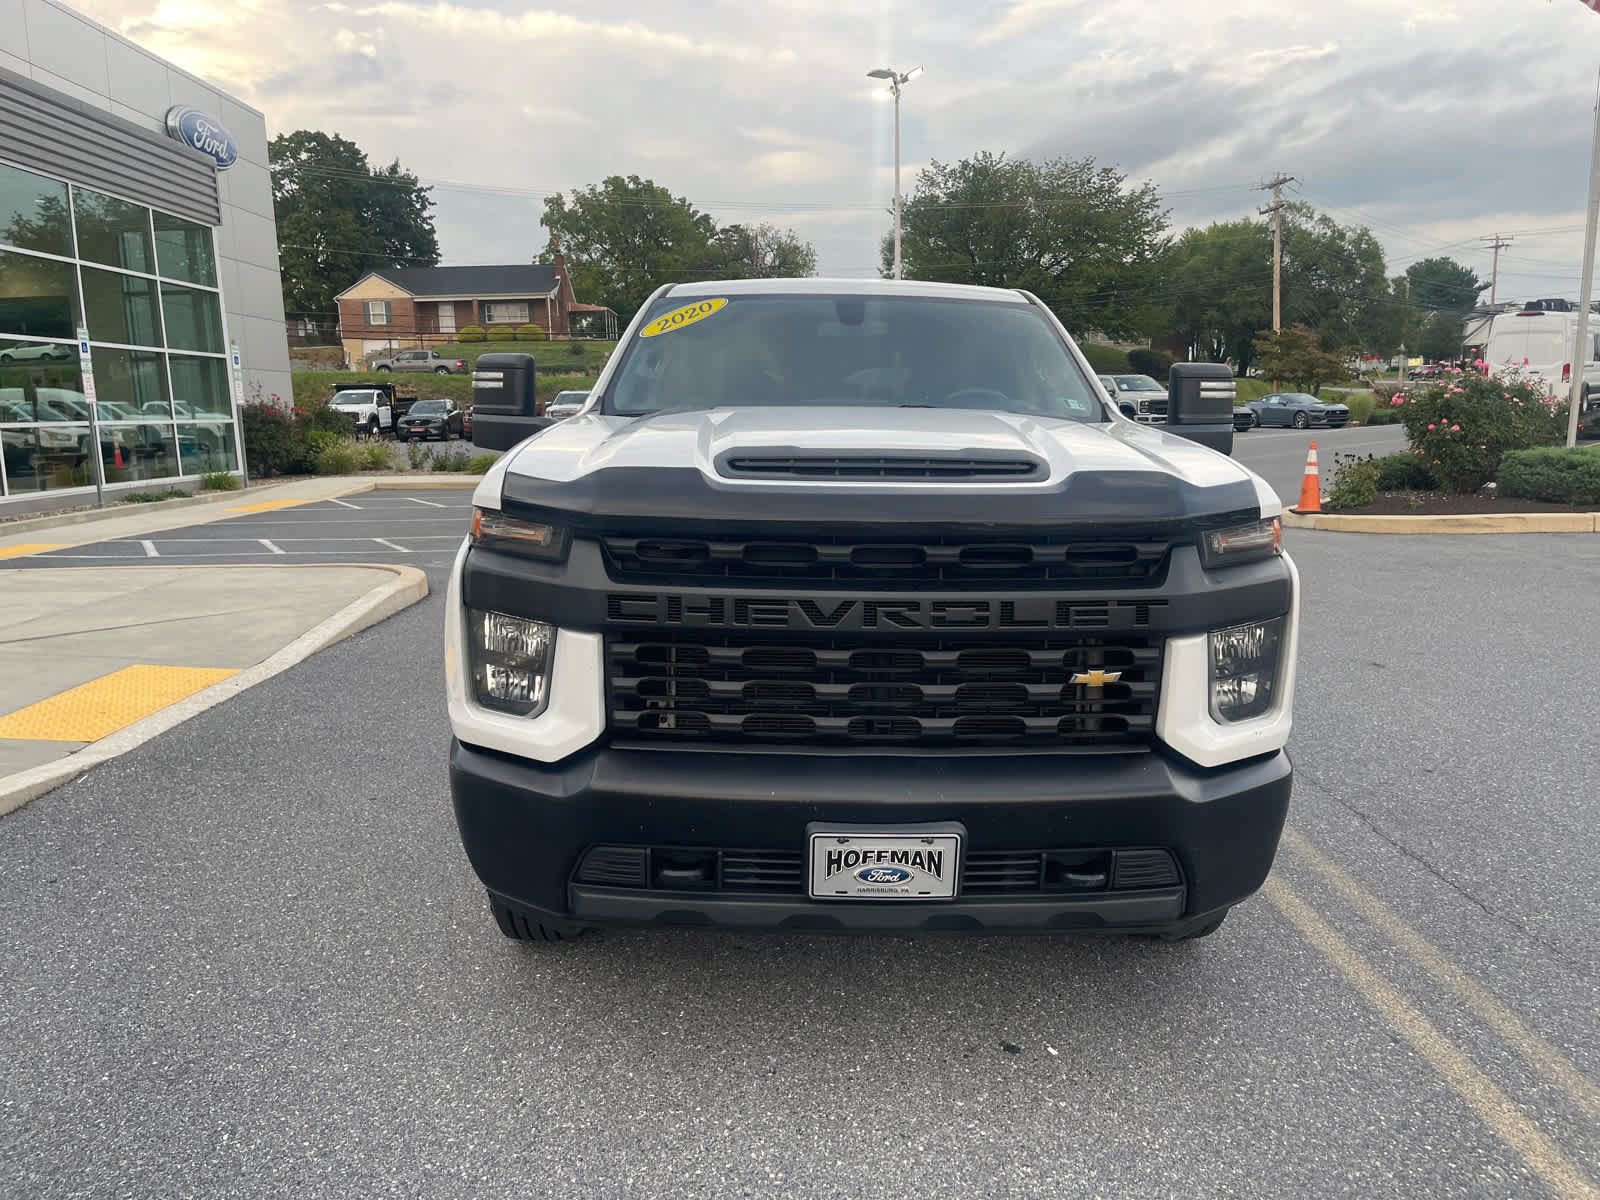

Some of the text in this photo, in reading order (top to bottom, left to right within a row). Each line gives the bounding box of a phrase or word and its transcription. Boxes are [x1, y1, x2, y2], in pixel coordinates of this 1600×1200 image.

[193, 119, 228, 159] Ford
[657, 302, 712, 331] 2020
[606, 594, 1169, 630] CHEVROLET
[825, 849, 943, 881] HOFFMAN
[867, 869, 900, 882] Ford
